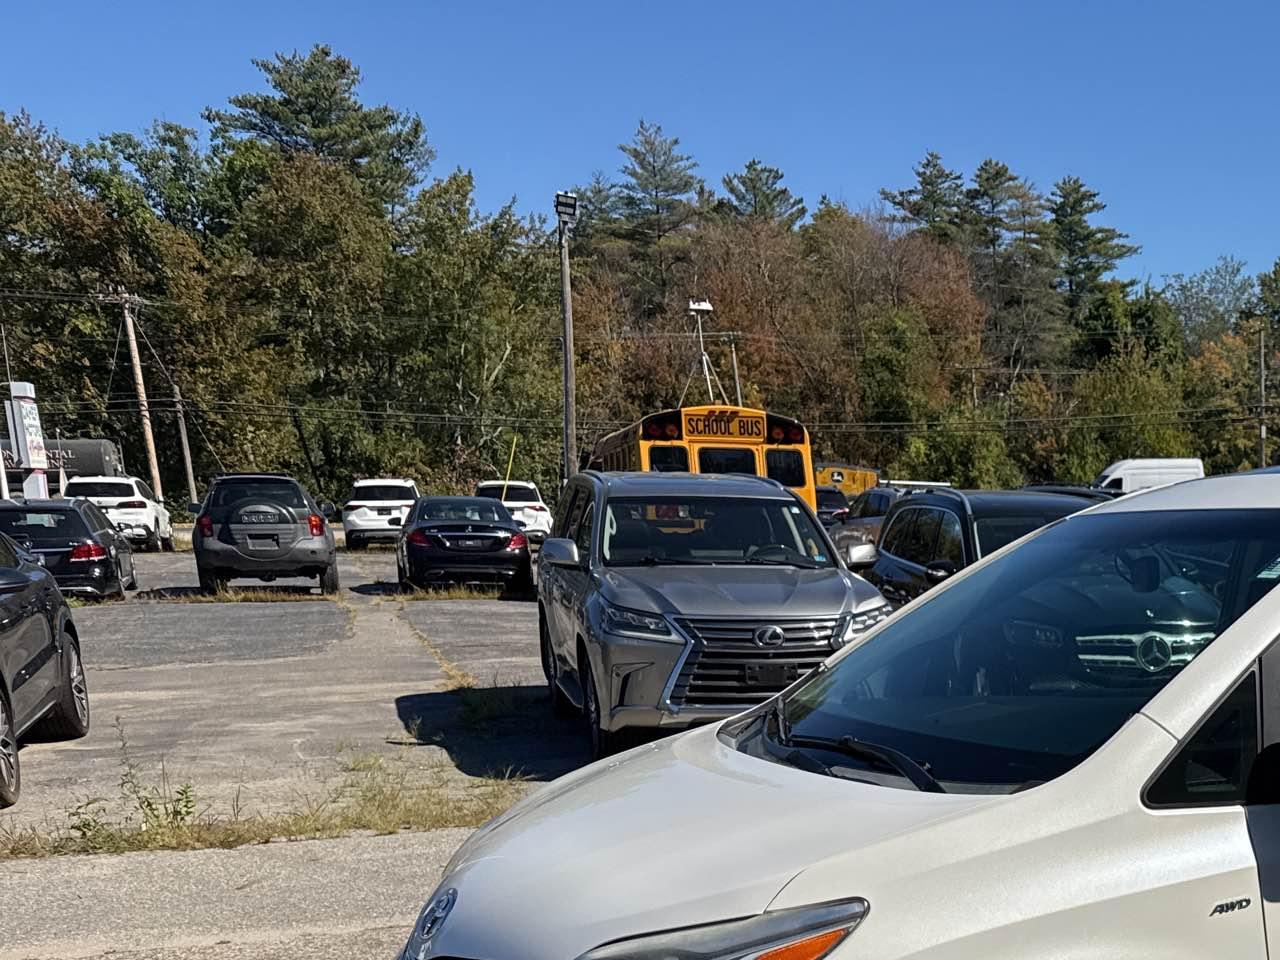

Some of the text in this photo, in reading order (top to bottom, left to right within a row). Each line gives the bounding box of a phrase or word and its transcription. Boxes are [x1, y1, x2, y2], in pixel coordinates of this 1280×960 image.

[687, 417, 762, 436] SCHOOL BUS
[1208, 897, 1252, 918] AWD
